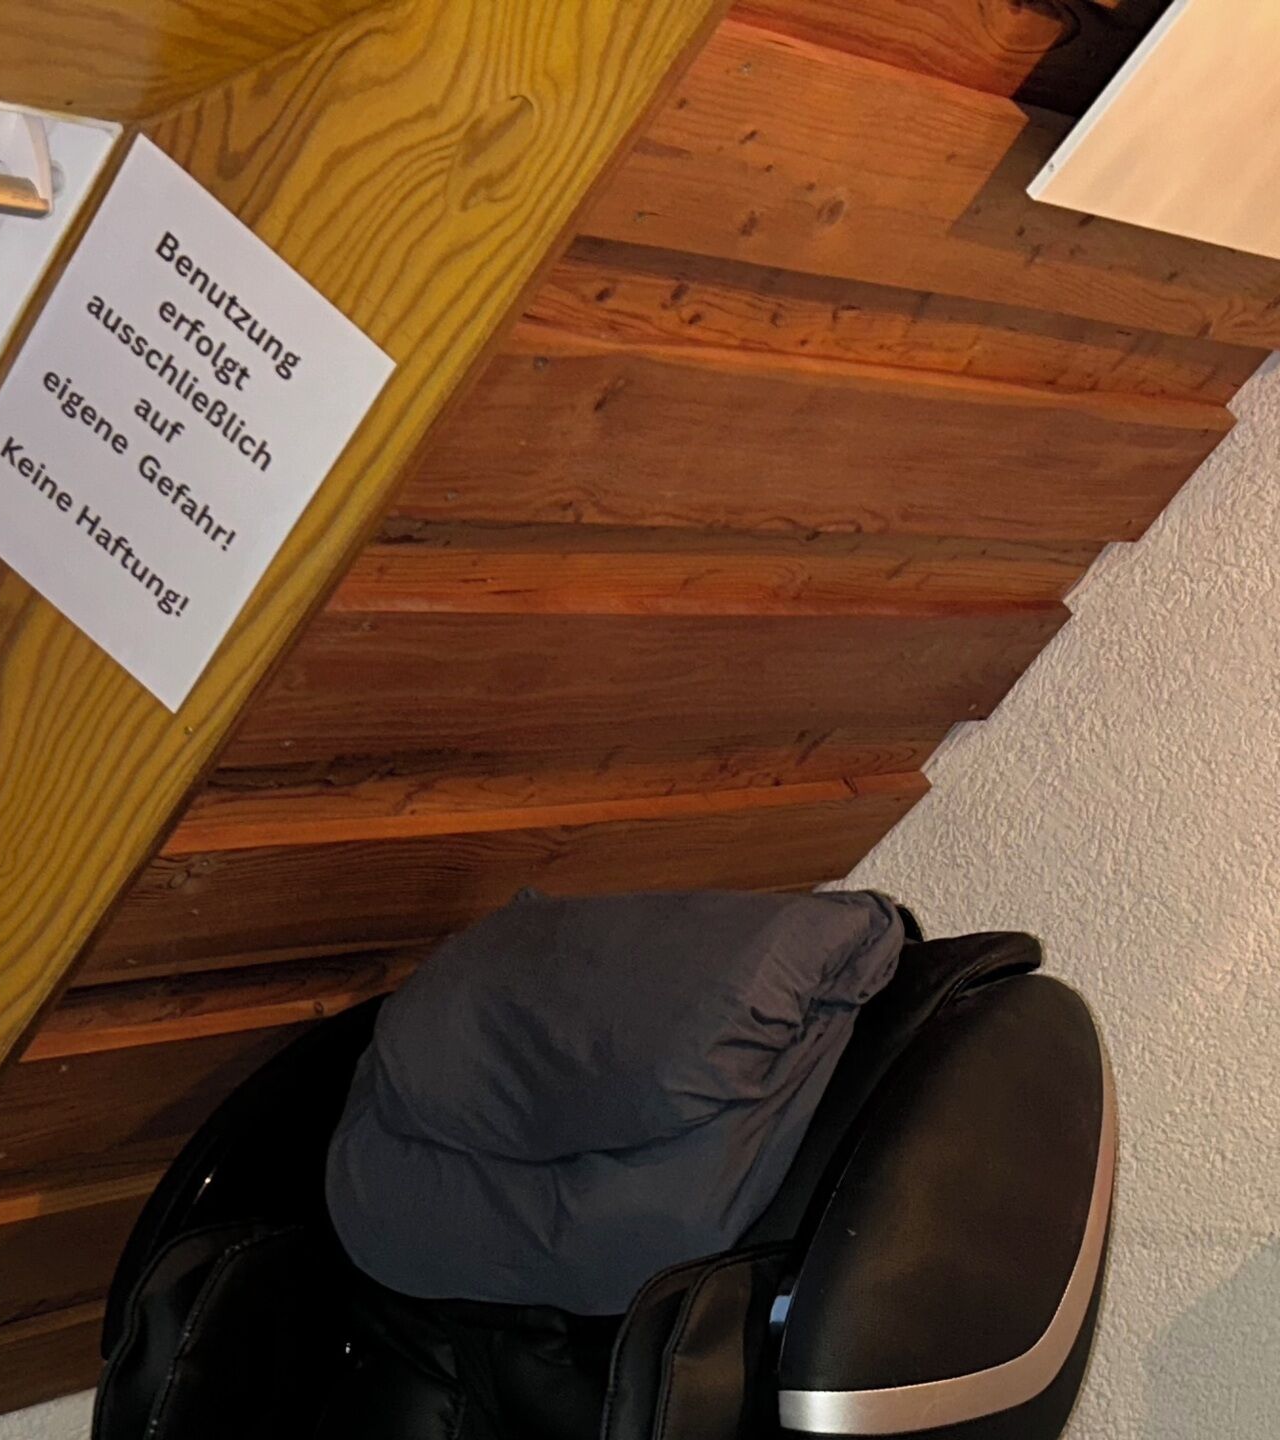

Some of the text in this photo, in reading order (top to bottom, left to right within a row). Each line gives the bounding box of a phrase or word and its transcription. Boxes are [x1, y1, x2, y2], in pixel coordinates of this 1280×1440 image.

[86, 295, 272, 472] ausschließlich
[155, 231, 301, 380] Benutzung
[158, 301, 251, 391] erfolgt
[43, 371, 236, 552] eigene Gefahr!
[134, 398, 185, 444] auf
[0, 436, 189, 617] Keine Haftung!
